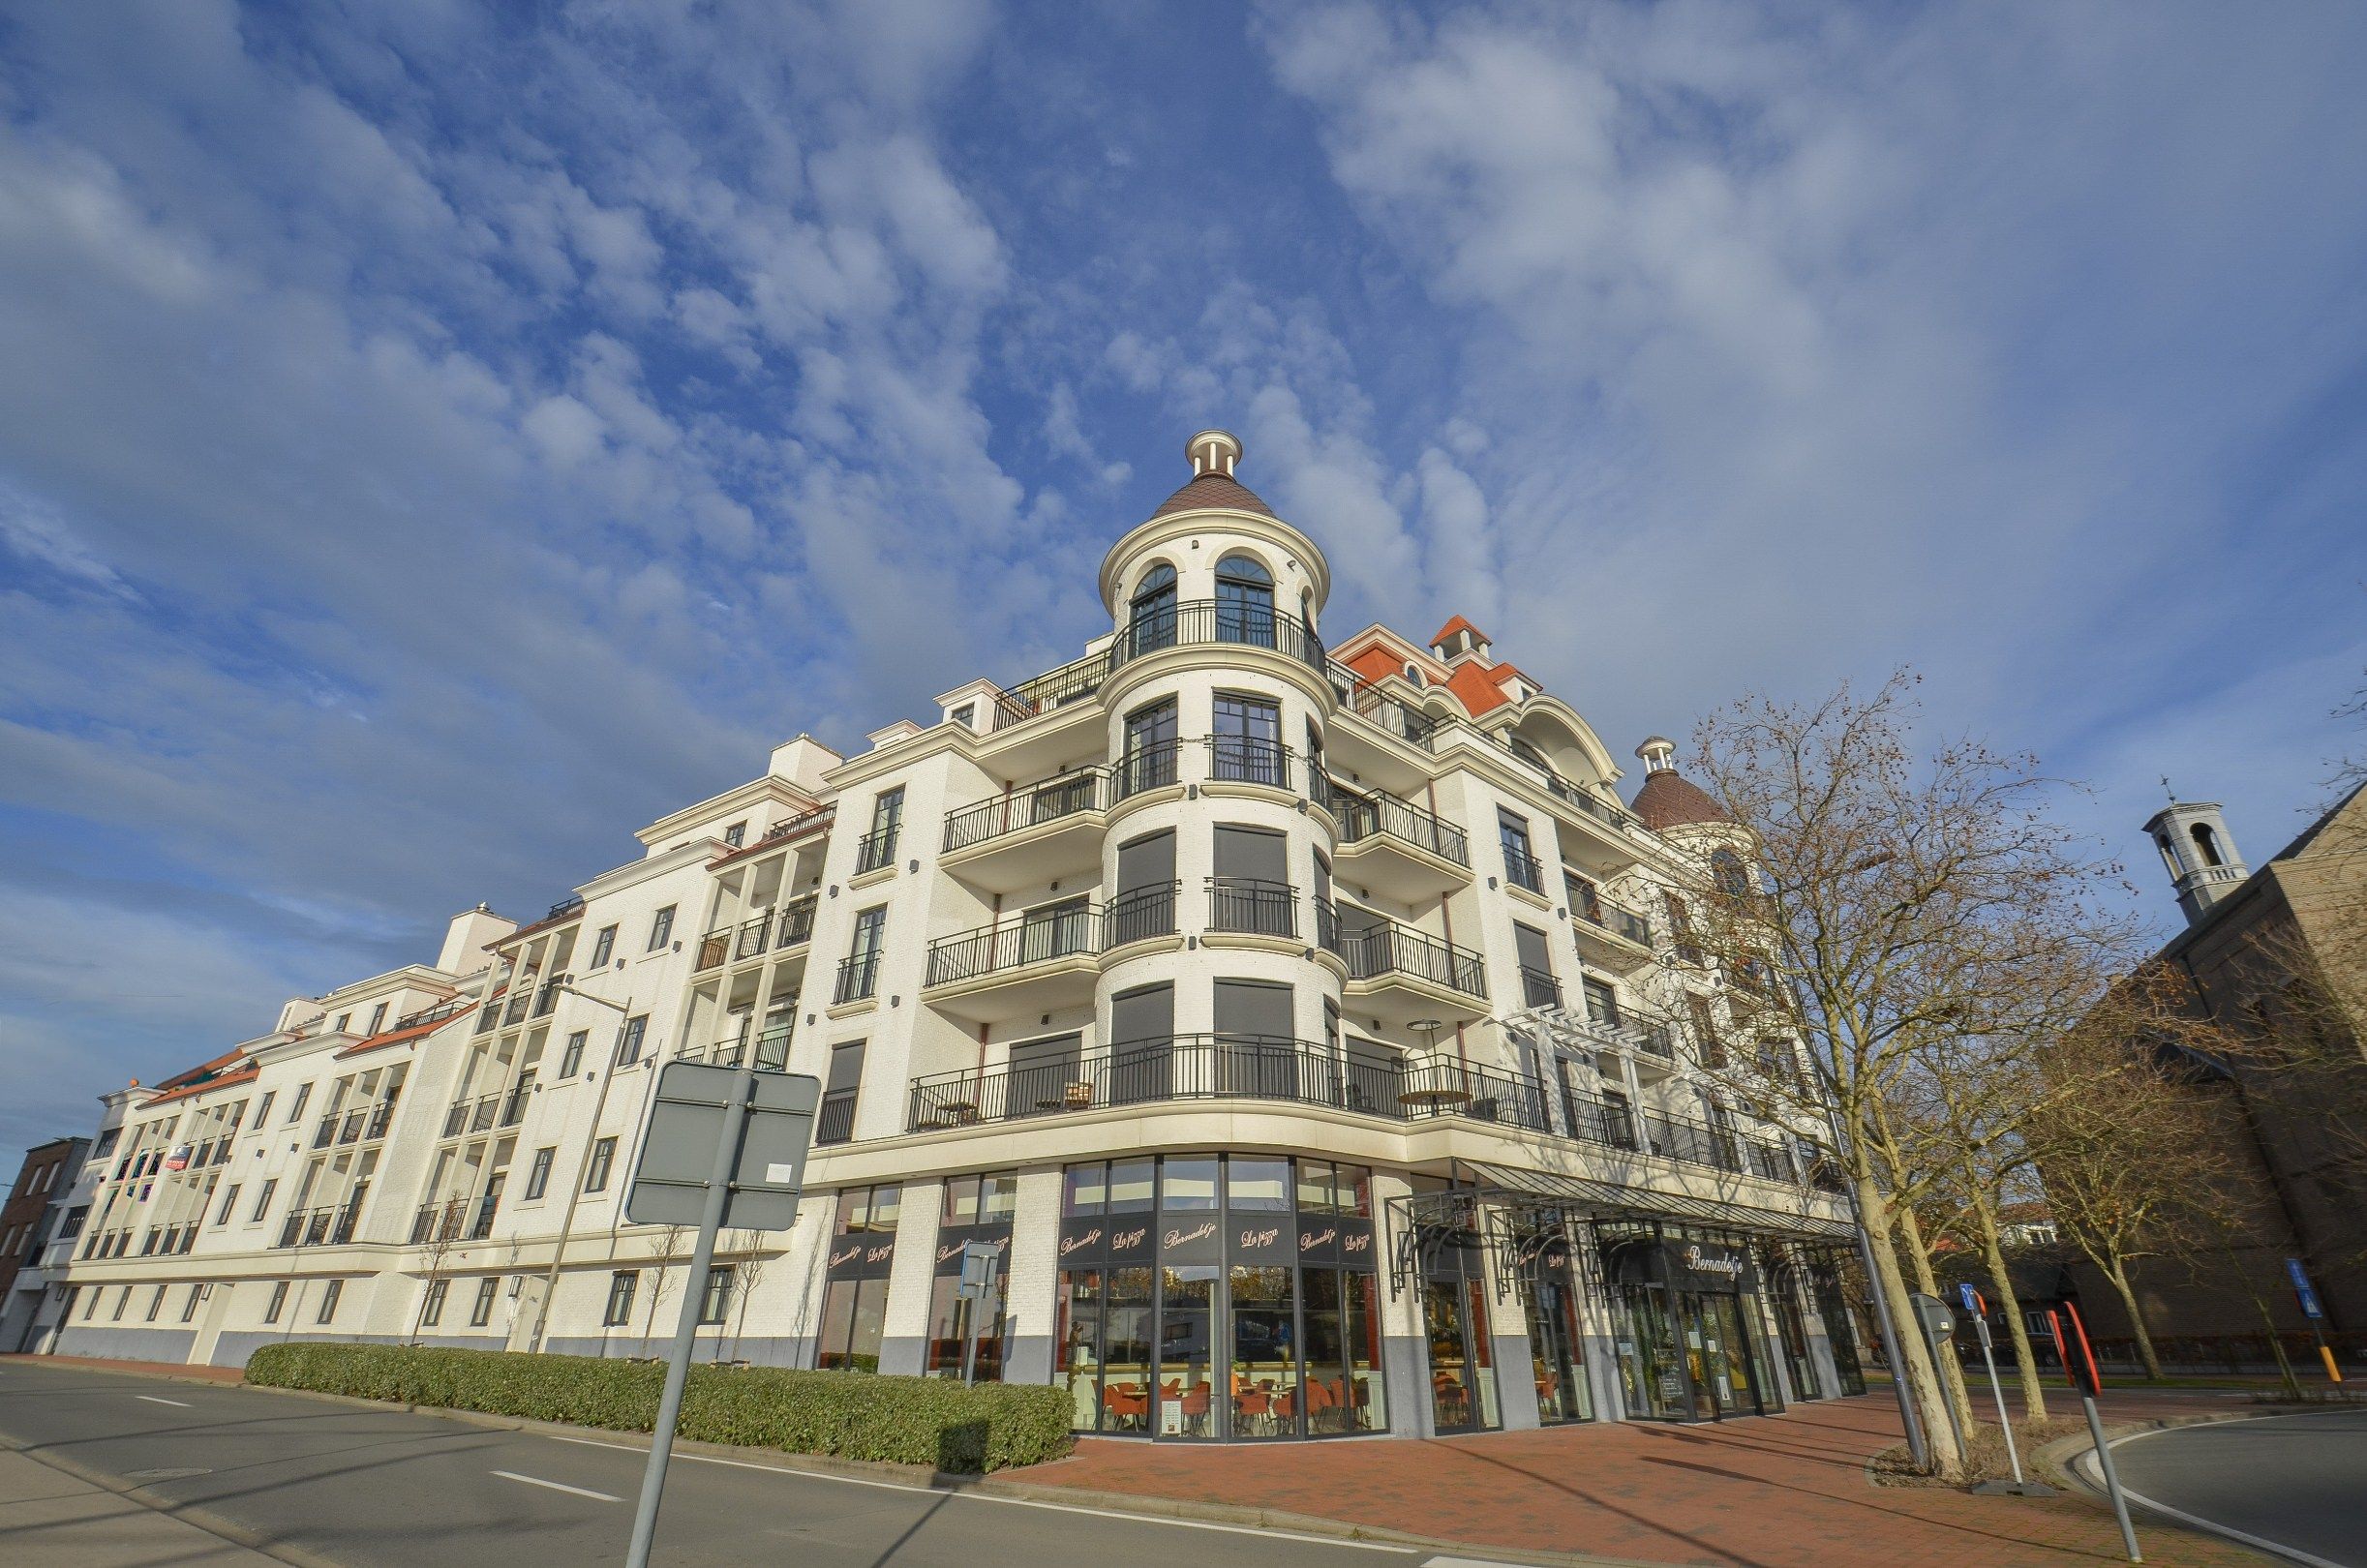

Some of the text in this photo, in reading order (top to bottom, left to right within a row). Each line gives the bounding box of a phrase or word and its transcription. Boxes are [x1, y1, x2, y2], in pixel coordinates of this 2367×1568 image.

[1113, 1228, 1146, 1250] La pizza
[1241, 1228, 1278, 1248] La pizza
[1688, 1246, 1743, 1282] Bernadetje
